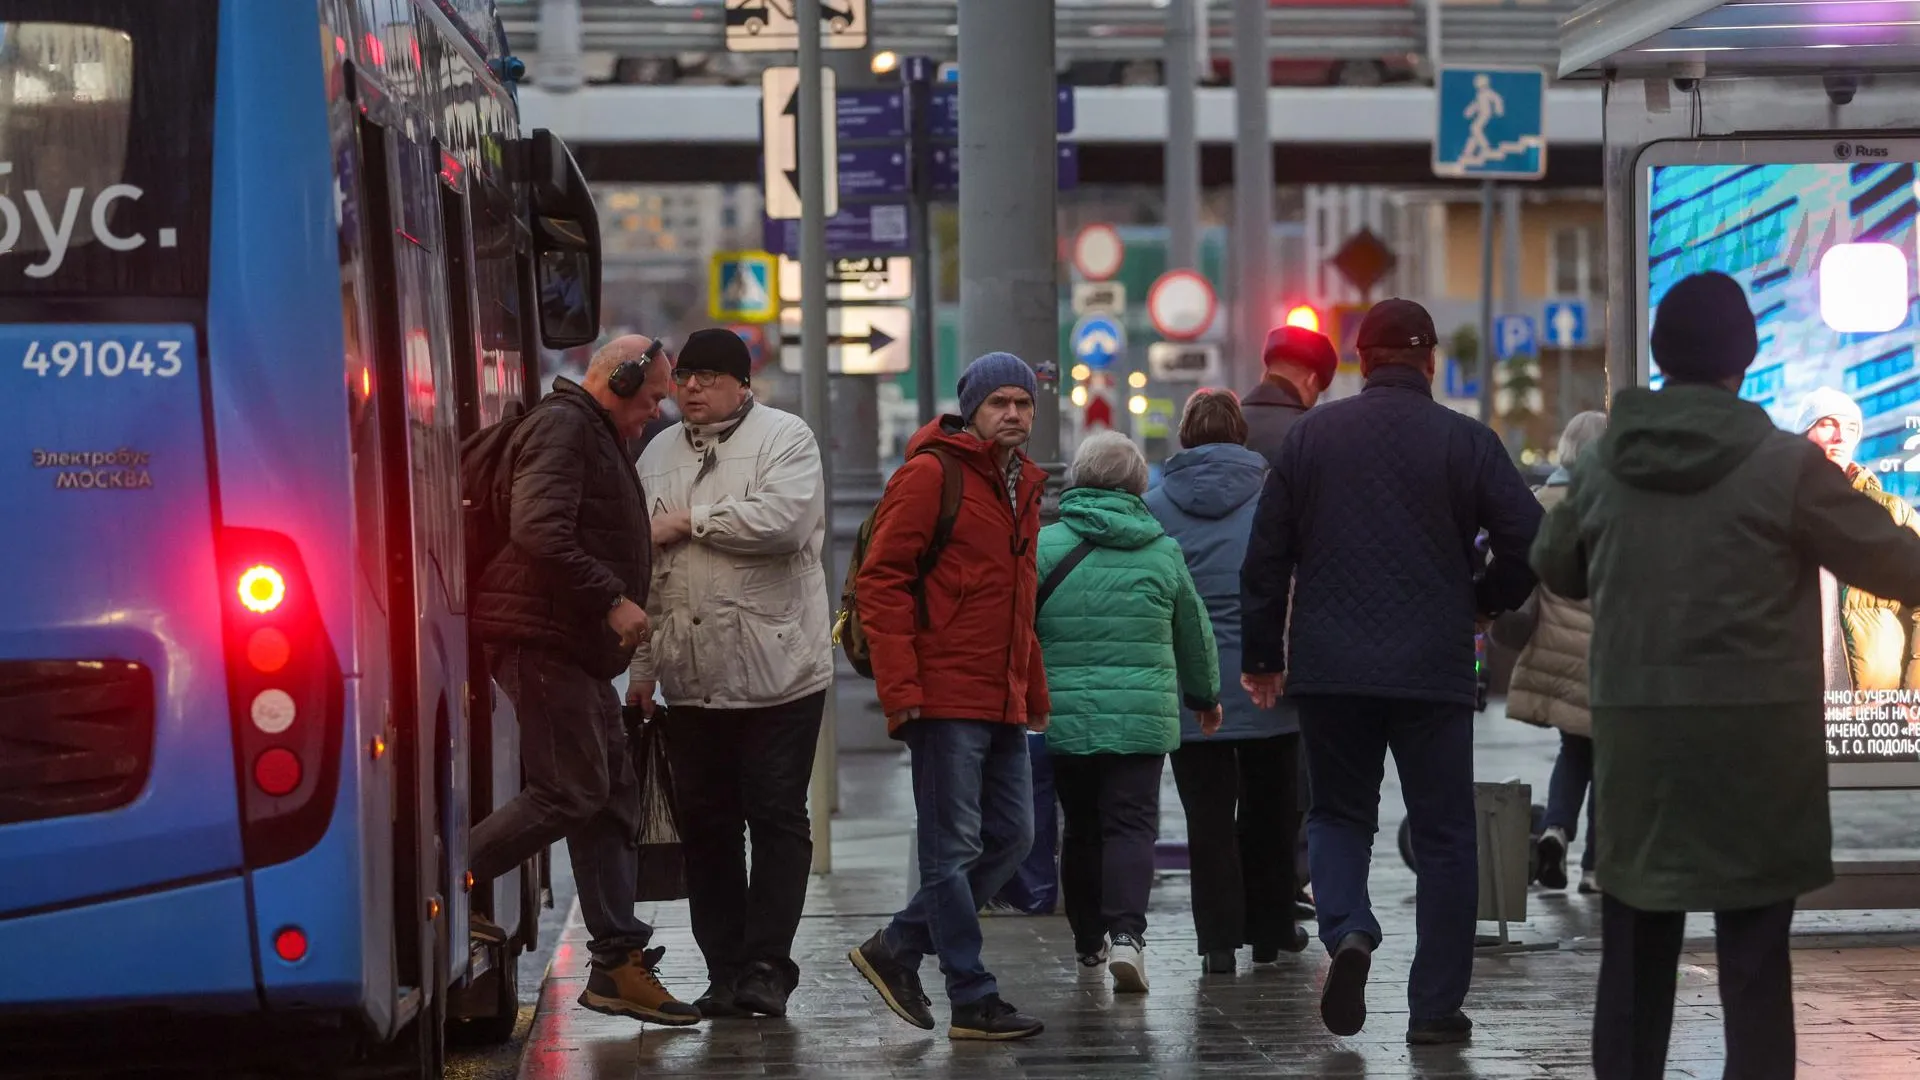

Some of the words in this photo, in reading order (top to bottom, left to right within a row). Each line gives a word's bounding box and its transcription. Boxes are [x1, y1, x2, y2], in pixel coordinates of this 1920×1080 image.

[1855, 144, 1889, 157] Russ
[22, 340, 182, 377] 491043
[32, 447, 150, 467] Электробус
[56, 471, 153, 489] МОСКВА
[1864, 689, 1911, 704] УЧЕТОМ
[1855, 706, 1889, 723] ЦЕНЫ
[1892, 705, 1908, 721] НА
[1871, 722, 1899, 737] ООО
